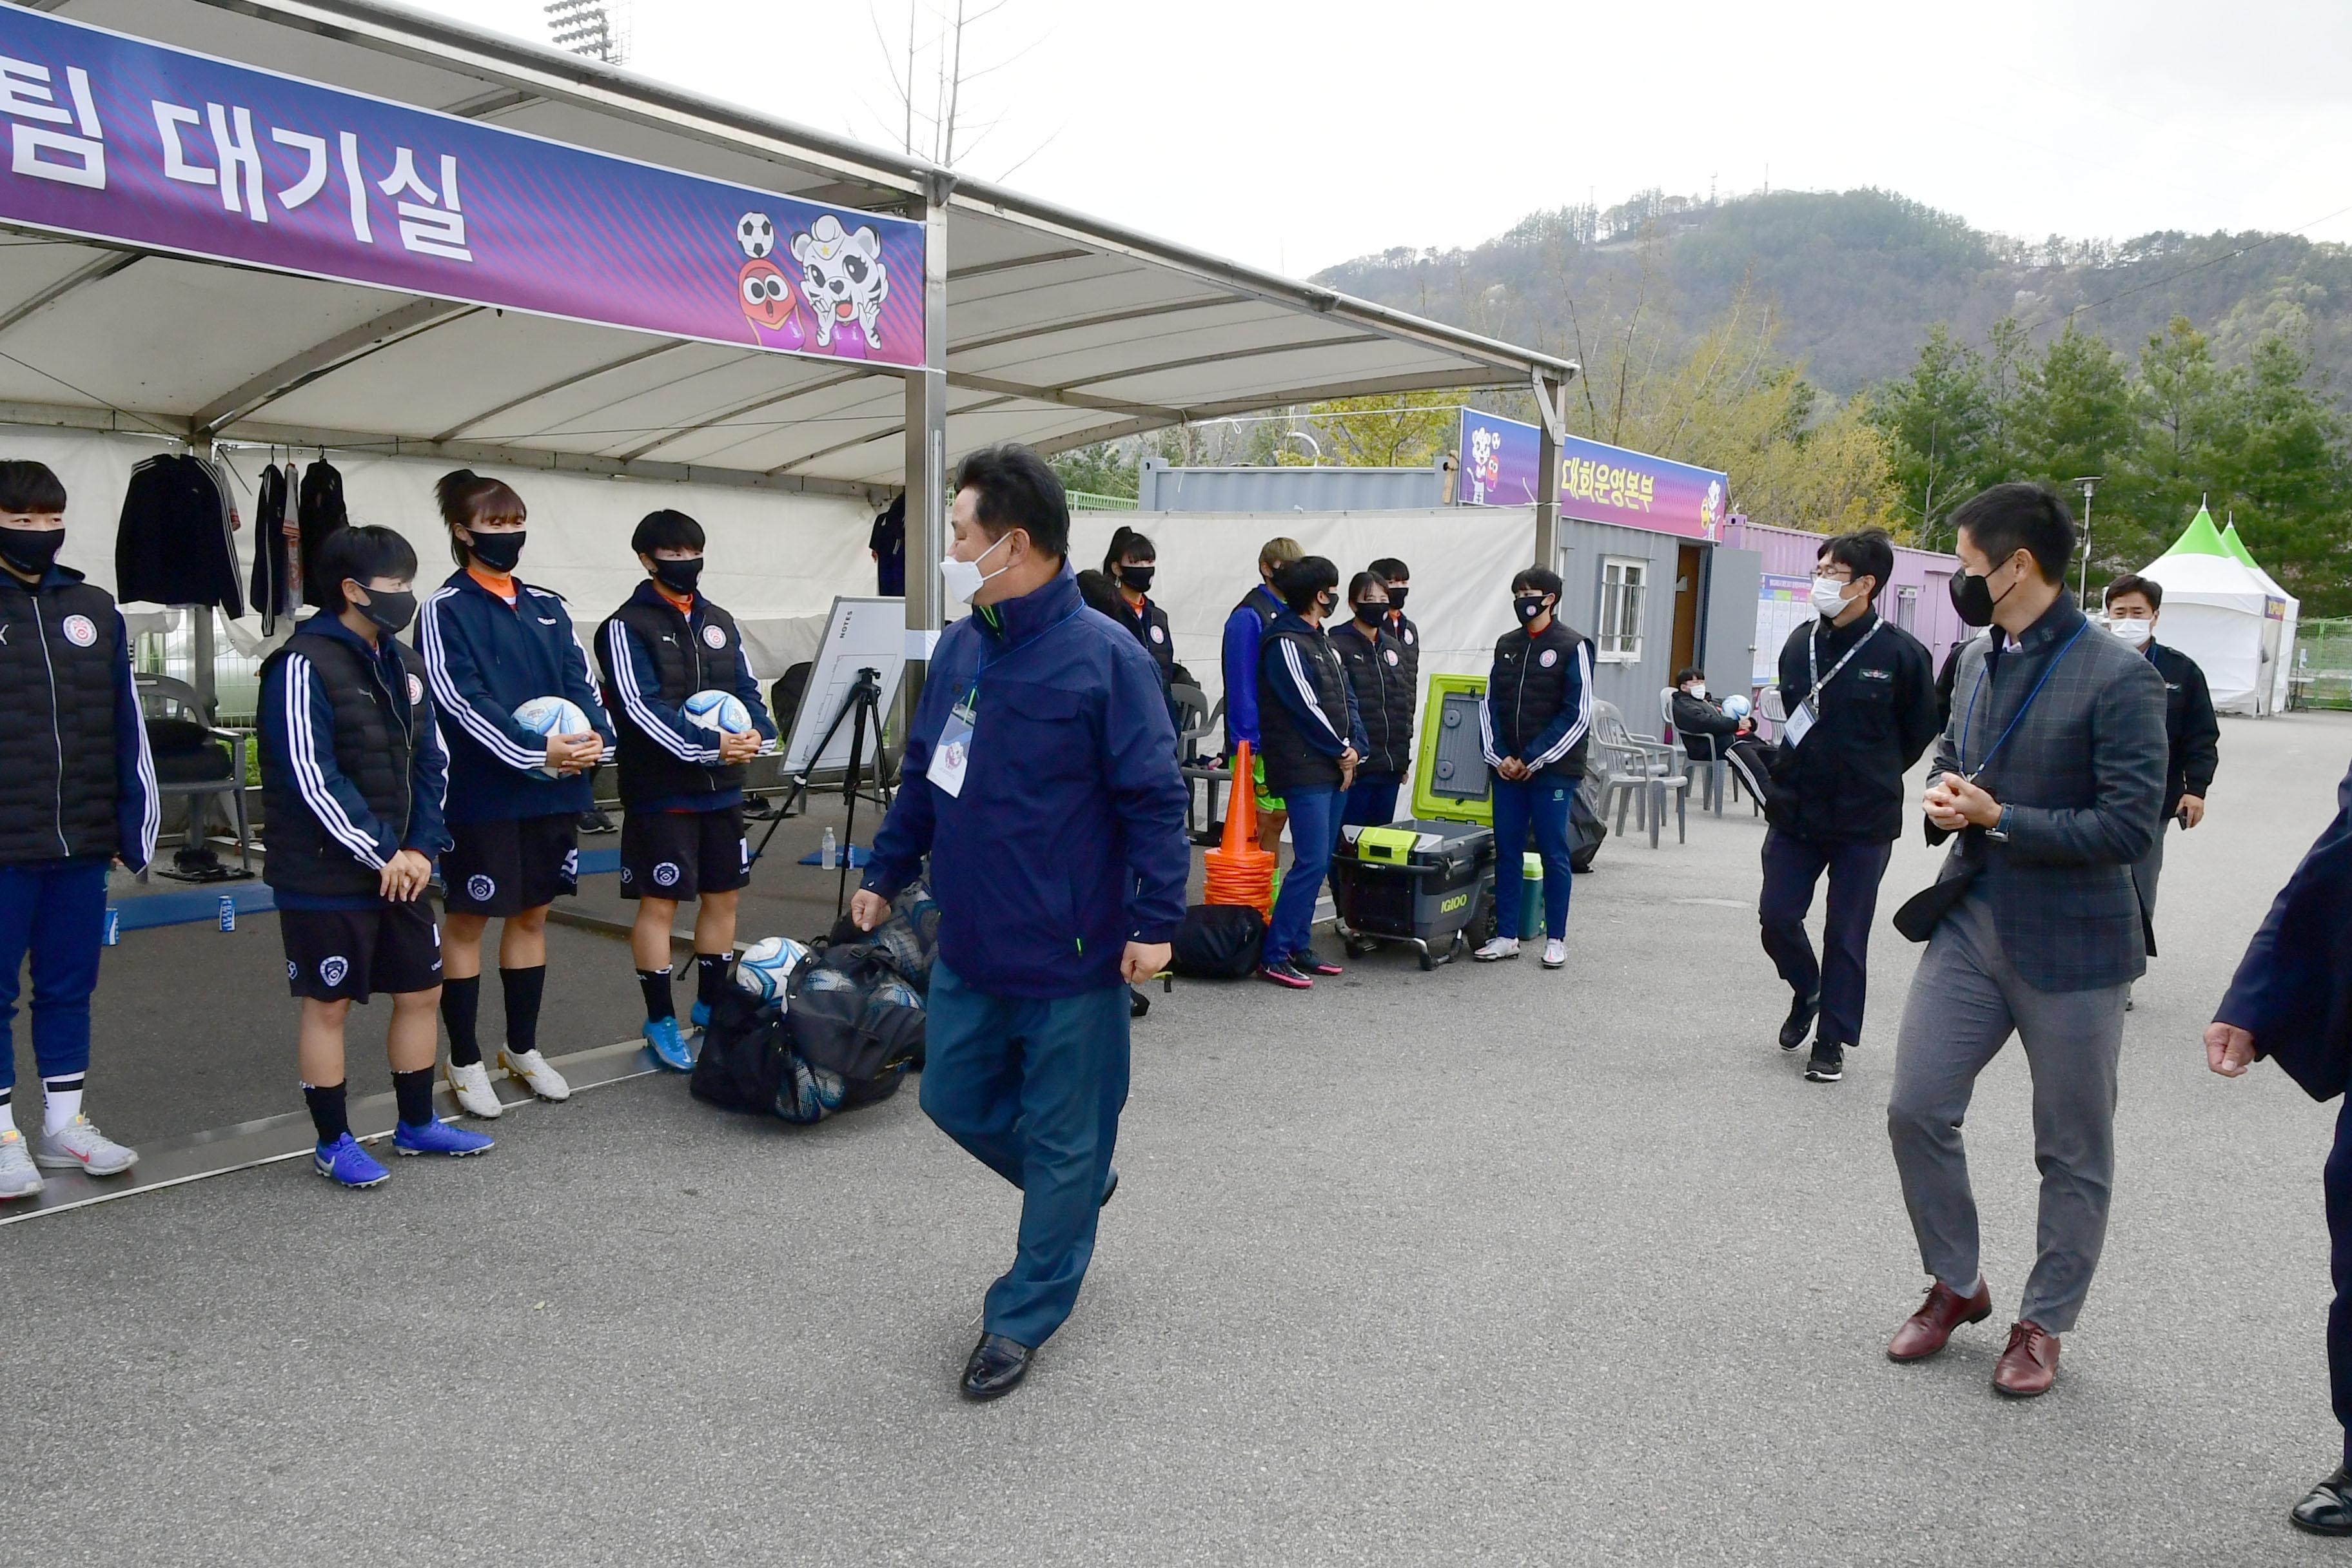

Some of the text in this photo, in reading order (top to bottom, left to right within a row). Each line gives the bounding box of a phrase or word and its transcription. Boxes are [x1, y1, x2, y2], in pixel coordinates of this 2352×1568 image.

[0, 55, 473, 262] 팀 대기실
[1561, 456, 1654, 513] 대회운영본부
[839, 611, 852, 638] NOTES
[1440, 894, 1467, 914] IGLOO
